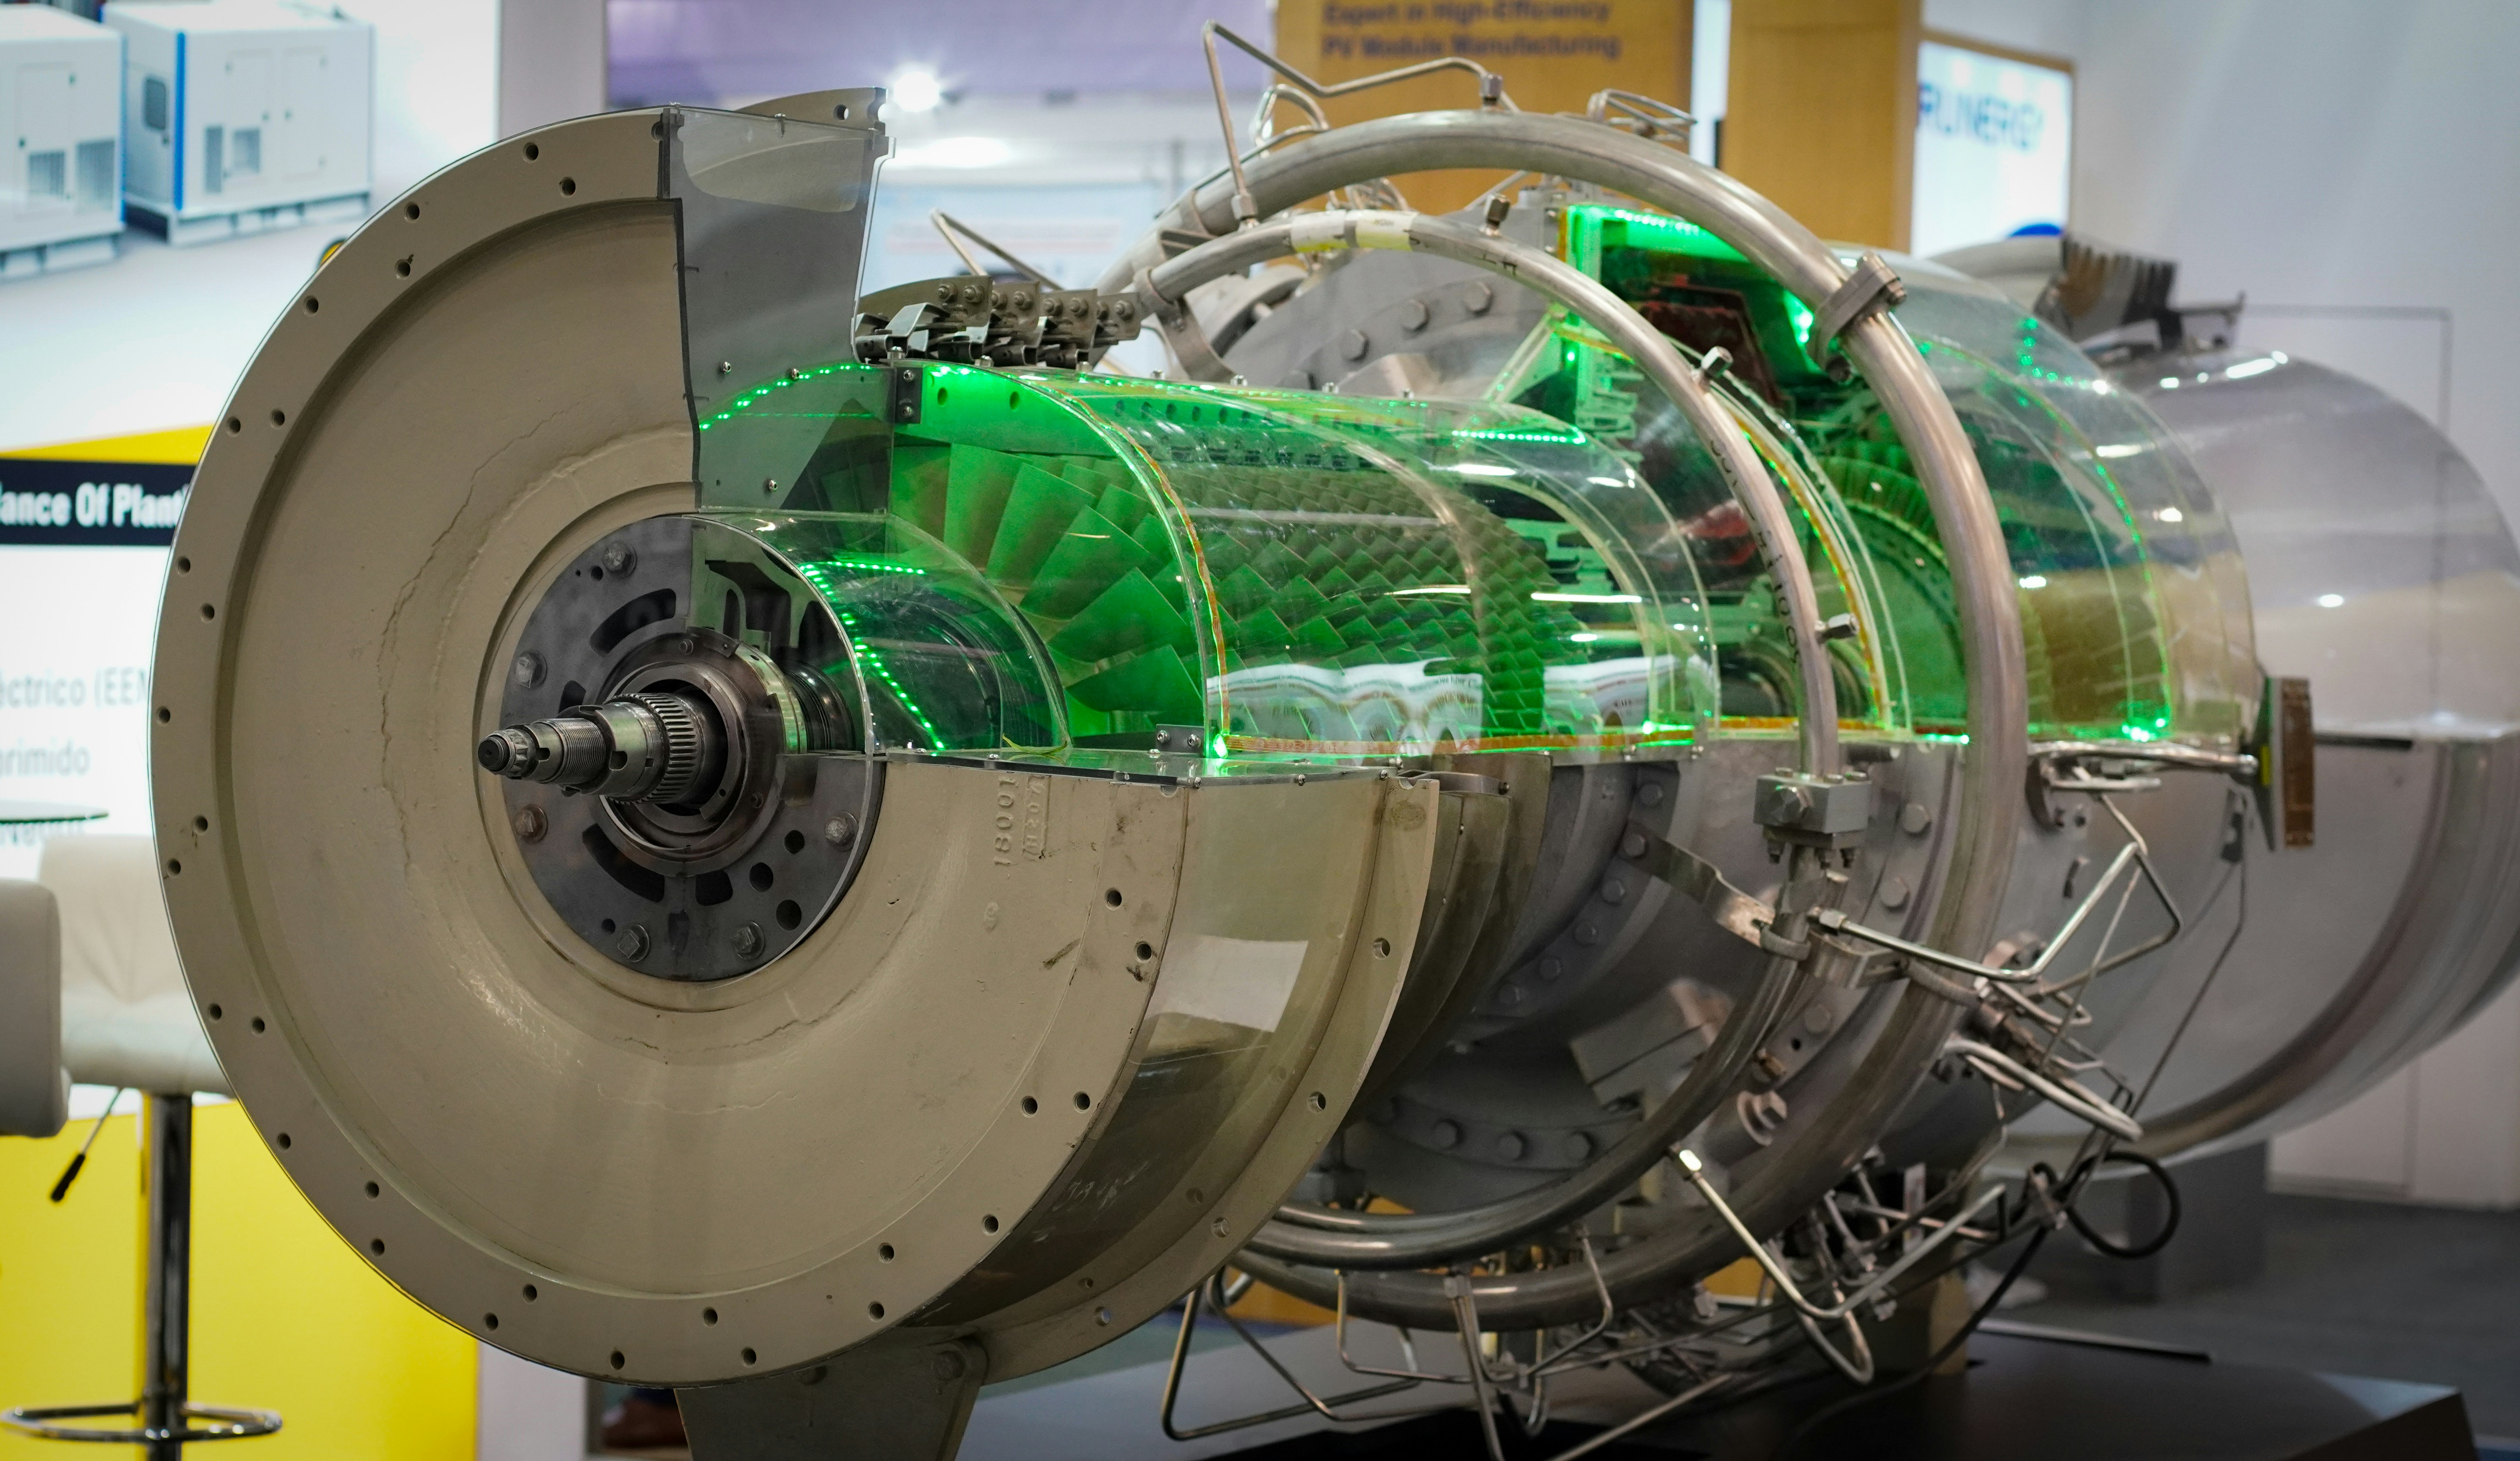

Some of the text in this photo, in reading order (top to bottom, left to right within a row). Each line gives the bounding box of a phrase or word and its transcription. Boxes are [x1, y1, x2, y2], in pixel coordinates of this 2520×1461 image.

[1406, 6, 1423, 21] in
[1322, 35, 1620, 60] PV Module Manufacturing
[0, 482, 71, 527] ance
[75, 482, 110, 528] Of
[0, 736, 91, 776] rimido
